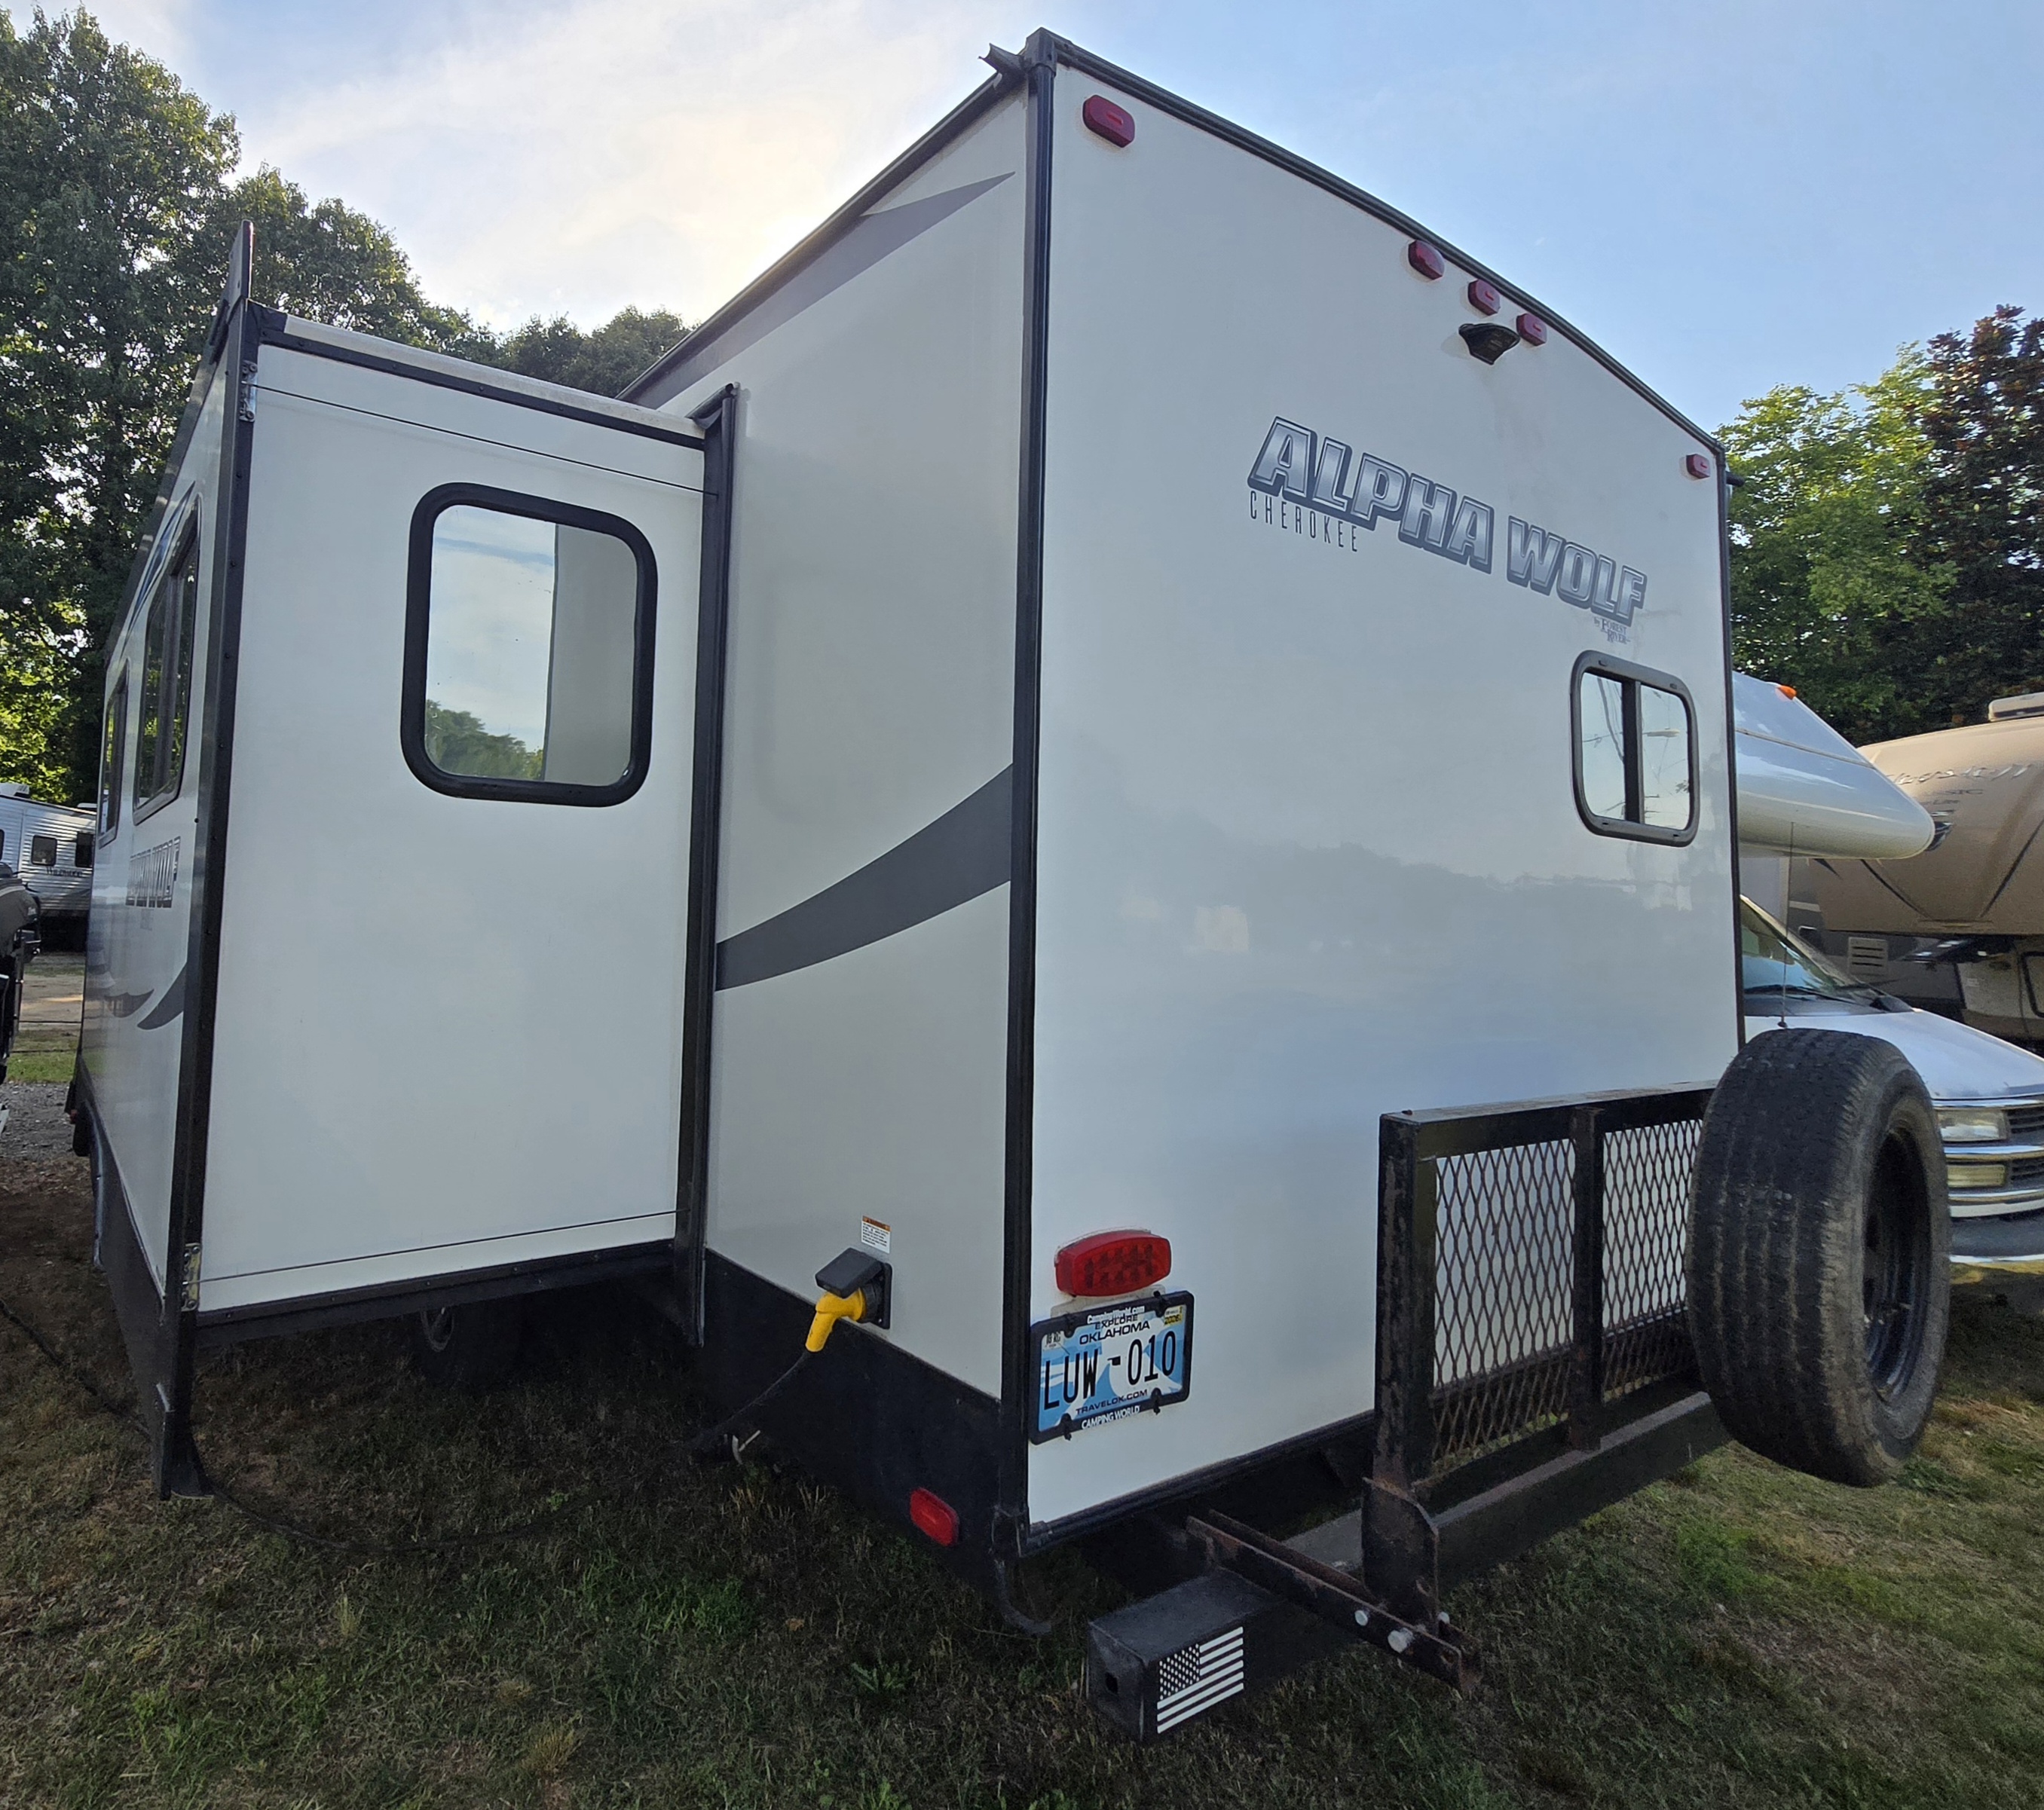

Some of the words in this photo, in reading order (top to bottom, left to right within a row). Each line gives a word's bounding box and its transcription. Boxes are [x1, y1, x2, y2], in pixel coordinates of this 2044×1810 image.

[1247, 415, 1494, 573] ALPHA
[1507, 515, 1647, 626] WOLF
[1250, 491, 1358, 552] CHEROKEE
[1079, 1320, 1150, 1344] OKLAHOMA
[1095, 1314, 1138, 1330] EXPLORE
[1076, 1389, 1147, 1415] TRAVELOK.COM
[1082, 1412, 1114, 1429] CAMPING
[1114, 1405, 1140, 1420] WORLD
